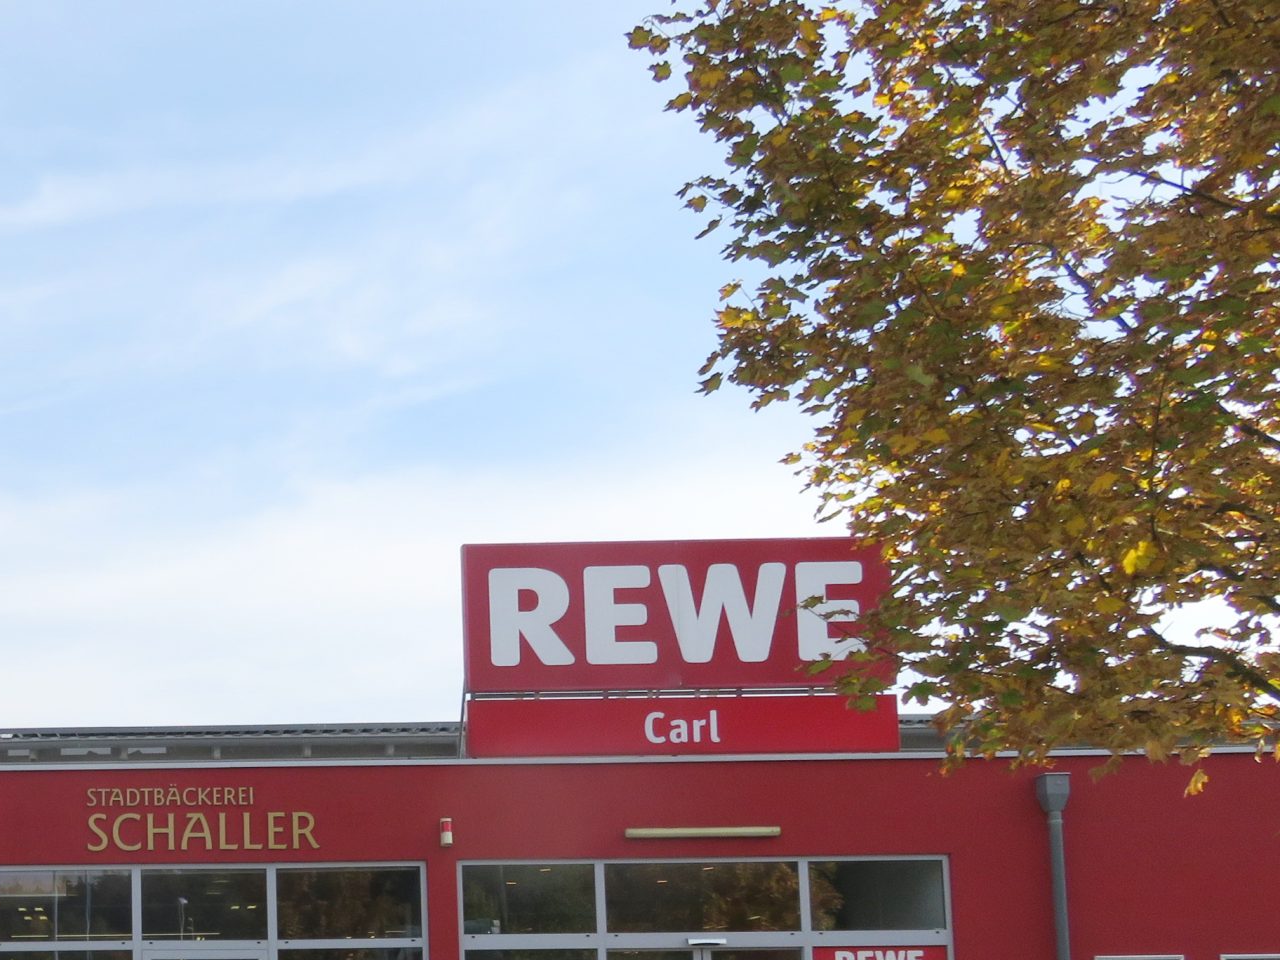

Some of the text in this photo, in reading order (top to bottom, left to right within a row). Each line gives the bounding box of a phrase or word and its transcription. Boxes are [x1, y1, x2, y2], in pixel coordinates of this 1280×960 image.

[488, 561, 867, 666] REWE
[644, 710, 721, 744] Carl
[86, 784, 254, 806] STADTBÄCKEREI
[87, 812, 320, 851] SCHALLER
